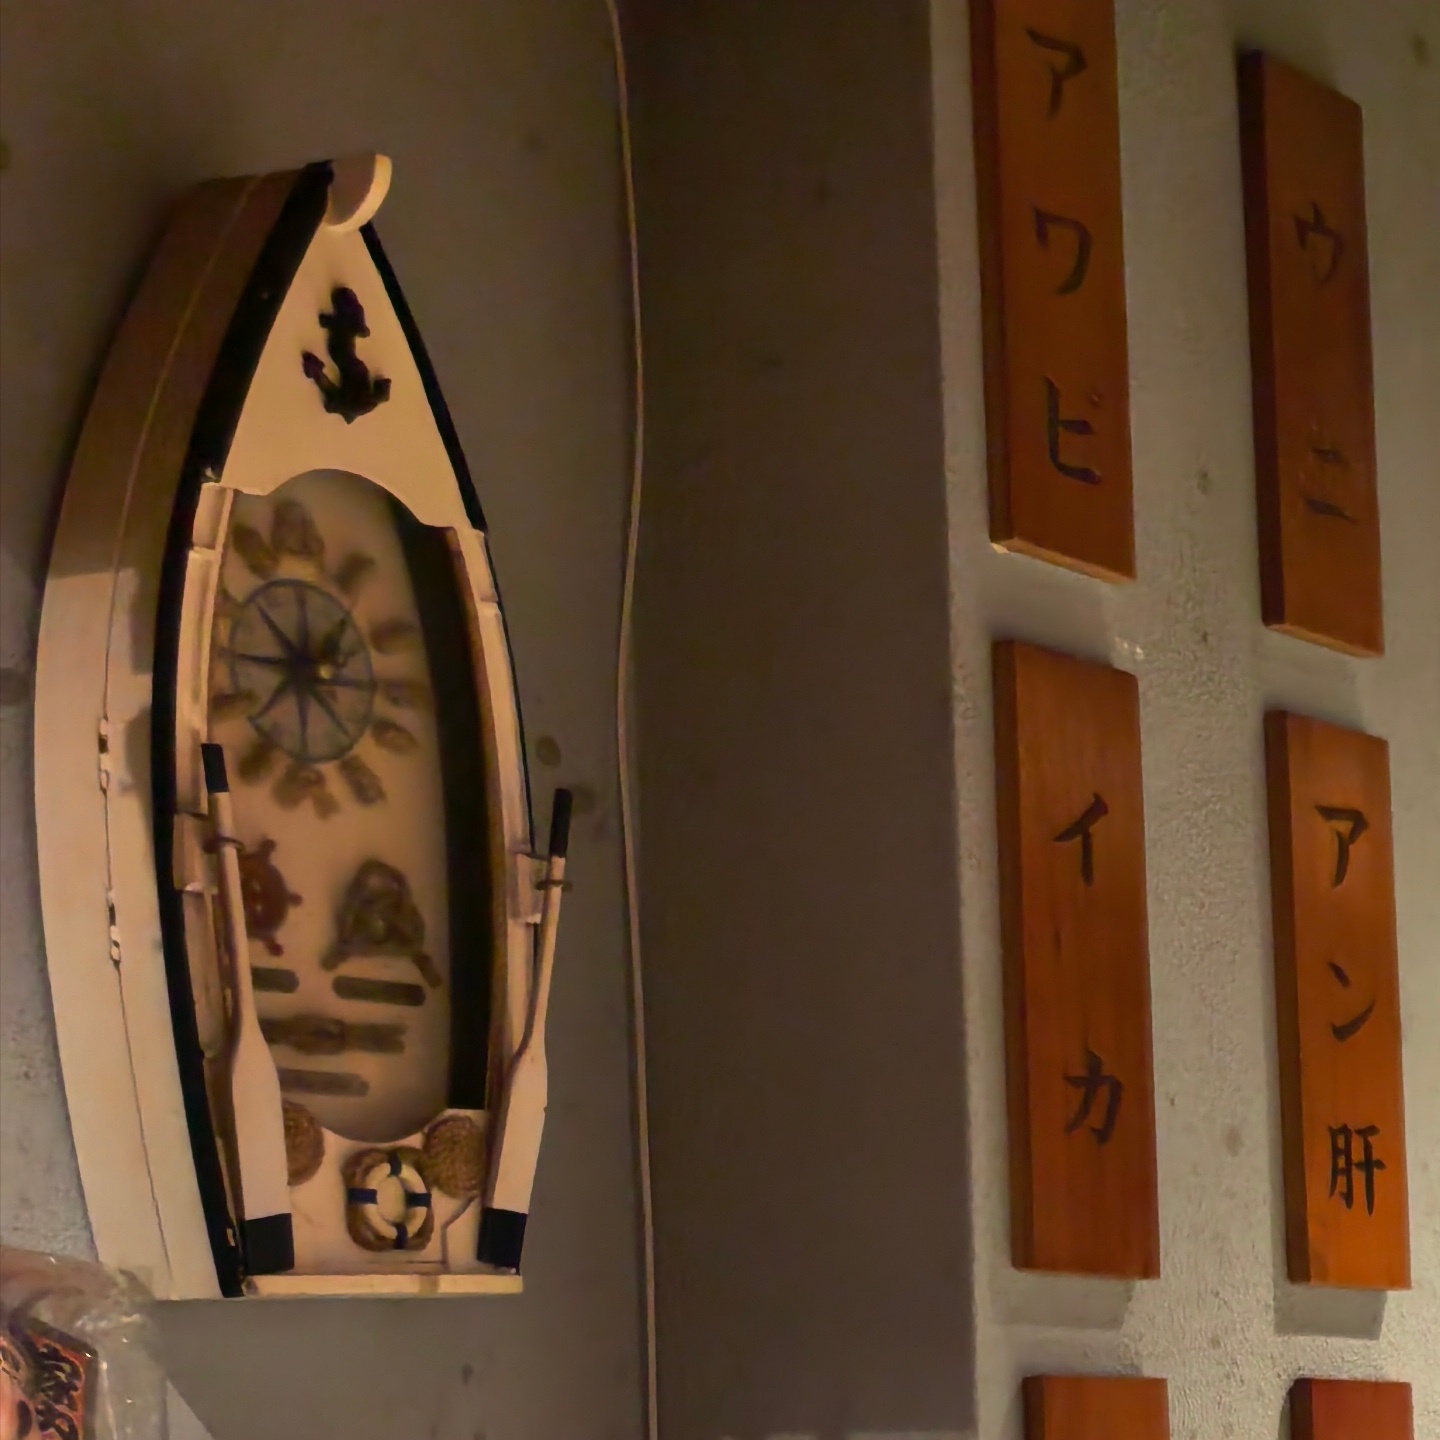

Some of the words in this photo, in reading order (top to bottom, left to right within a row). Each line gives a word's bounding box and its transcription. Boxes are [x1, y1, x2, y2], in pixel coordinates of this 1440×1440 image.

[1053, 791, 1123, 1145] イカ
[1315, 805, 1386, 1216] アン肝
